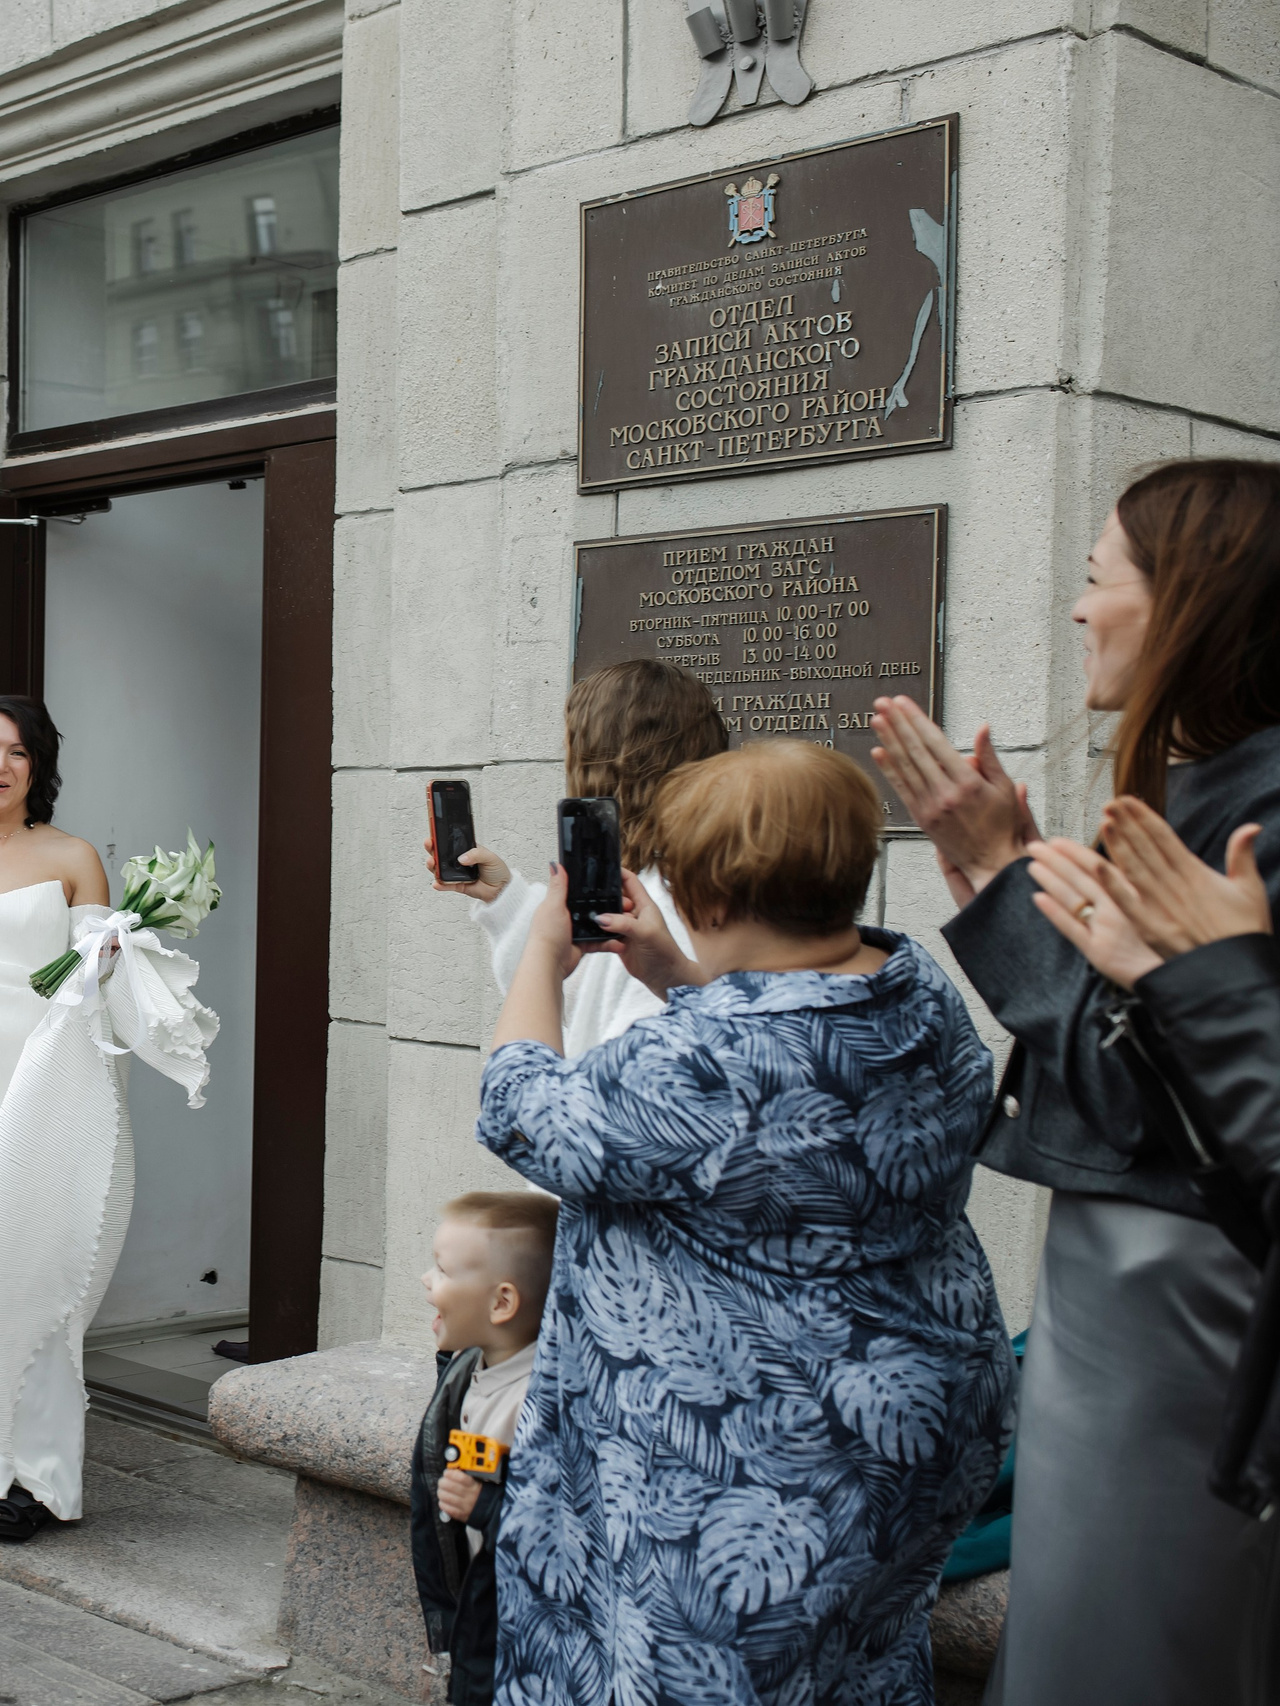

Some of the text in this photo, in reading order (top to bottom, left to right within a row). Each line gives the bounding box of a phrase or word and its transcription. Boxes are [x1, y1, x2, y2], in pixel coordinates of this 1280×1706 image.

[647, 228, 868, 282] ПРАВИТЕЛЬСТВО САНКТ-ПЕТЕРБУРГА
[648, 245, 867, 298] КОМИТЕТ ПО ДЕЛАМ ЗАПИСИ АКТОВ
[669, 265, 843, 307] ГРАЖДАНСКОГО СОСТОЯНИЯ
[710, 294, 794, 328] ОТДЕЛ
[655, 310, 853, 364] ЗАПИСИ АКТОВ
[648, 337, 860, 391] ГРАЖДАНСКОГО
[675, 369, 829, 412] СОСТОЯНИЯ
[609, 401, 790, 447] МОСКОВСКОГО
[625, 416, 883, 470] САНКТ-ПЕТЕРБУРГА
[663, 536, 835, 567] ПРИЕМ ГРАЖДАН
[671, 559, 822, 586] ОТДЕЛОМ ЗАГС
[639, 576, 860, 608] МОСКОВСКОГО РАЙОНА
[629, 610, 769, 632] ВТОРНИК-ПЯТНИЦА
[656, 633, 721, 649] СУББОТА
[656, 653, 721, 667] РЕРЫВ
[696, 662, 921, 685] НЕДЕЛЬНИК-ВЫХОДНОЙ ДЕНЬ
[732, 692, 831, 712] ГРАЖДАН
[749, 714, 829, 733] ОТДЕЛА
[837, 712, 876, 729] ЗАГ
